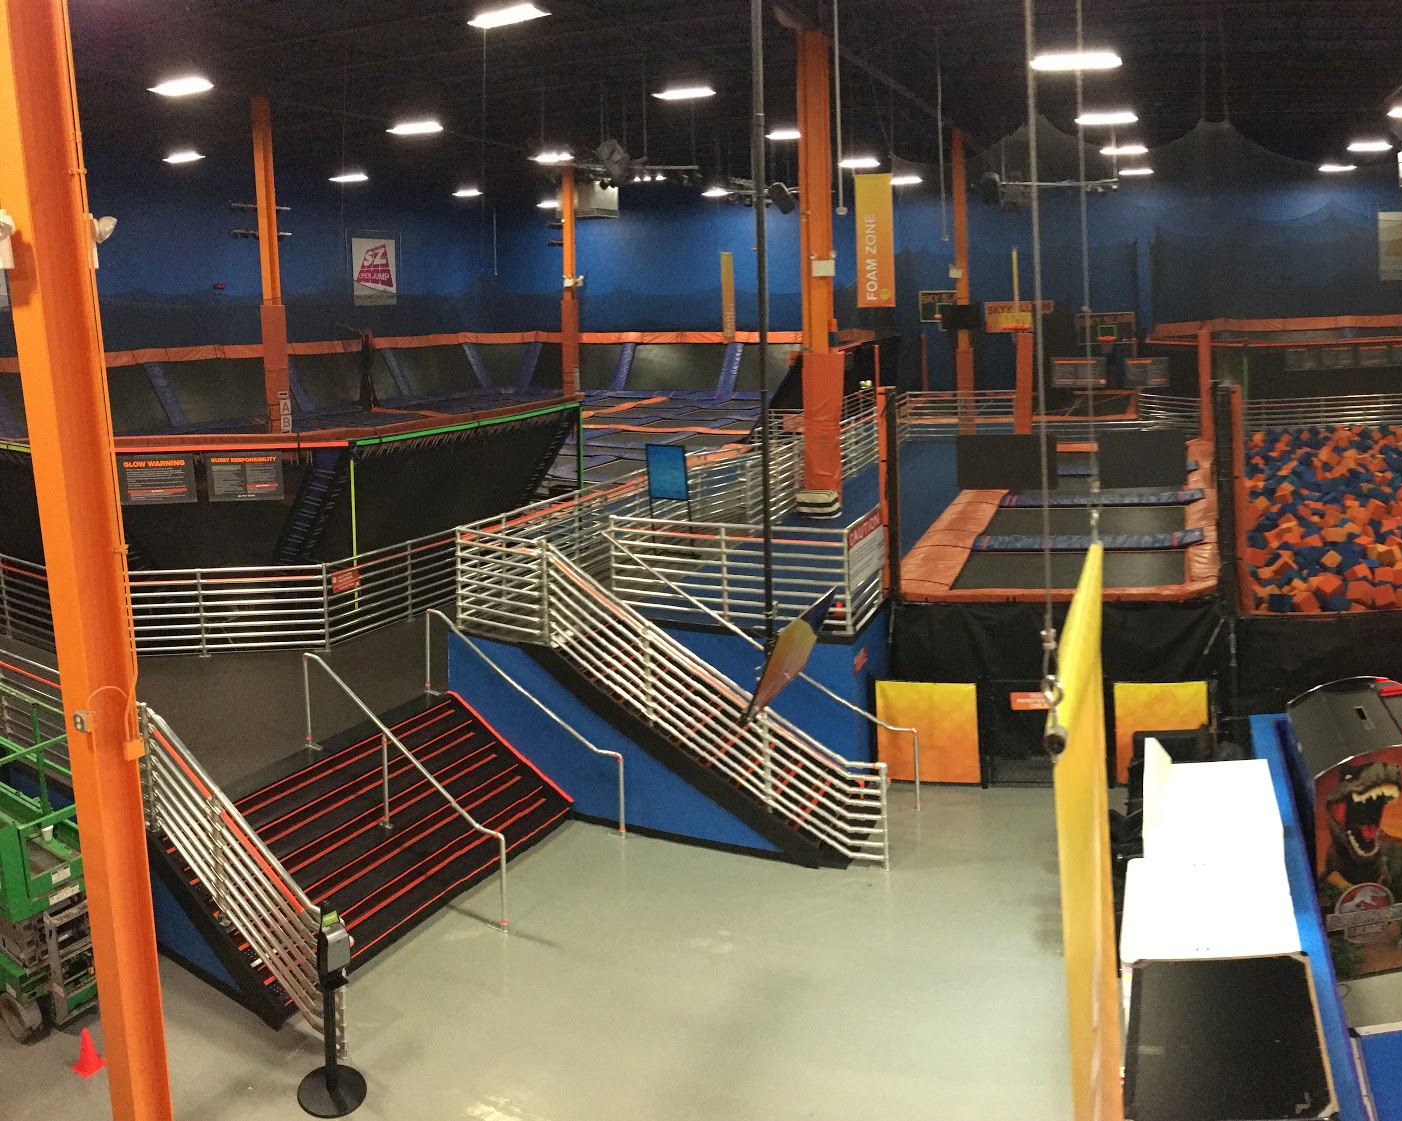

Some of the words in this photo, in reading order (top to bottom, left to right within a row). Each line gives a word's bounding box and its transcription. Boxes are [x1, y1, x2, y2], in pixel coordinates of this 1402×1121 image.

[864, 214, 877, 254] ZONE
[363, 247, 388, 267] SZ
[372, 272, 390, 281] JUMP
[866, 258, 878, 301] FOAM
[282, 401, 290, 413] A
[283, 417, 290, 428] B
[123, 460, 146, 468] GLOW
[148, 459, 185, 467] WARNING
